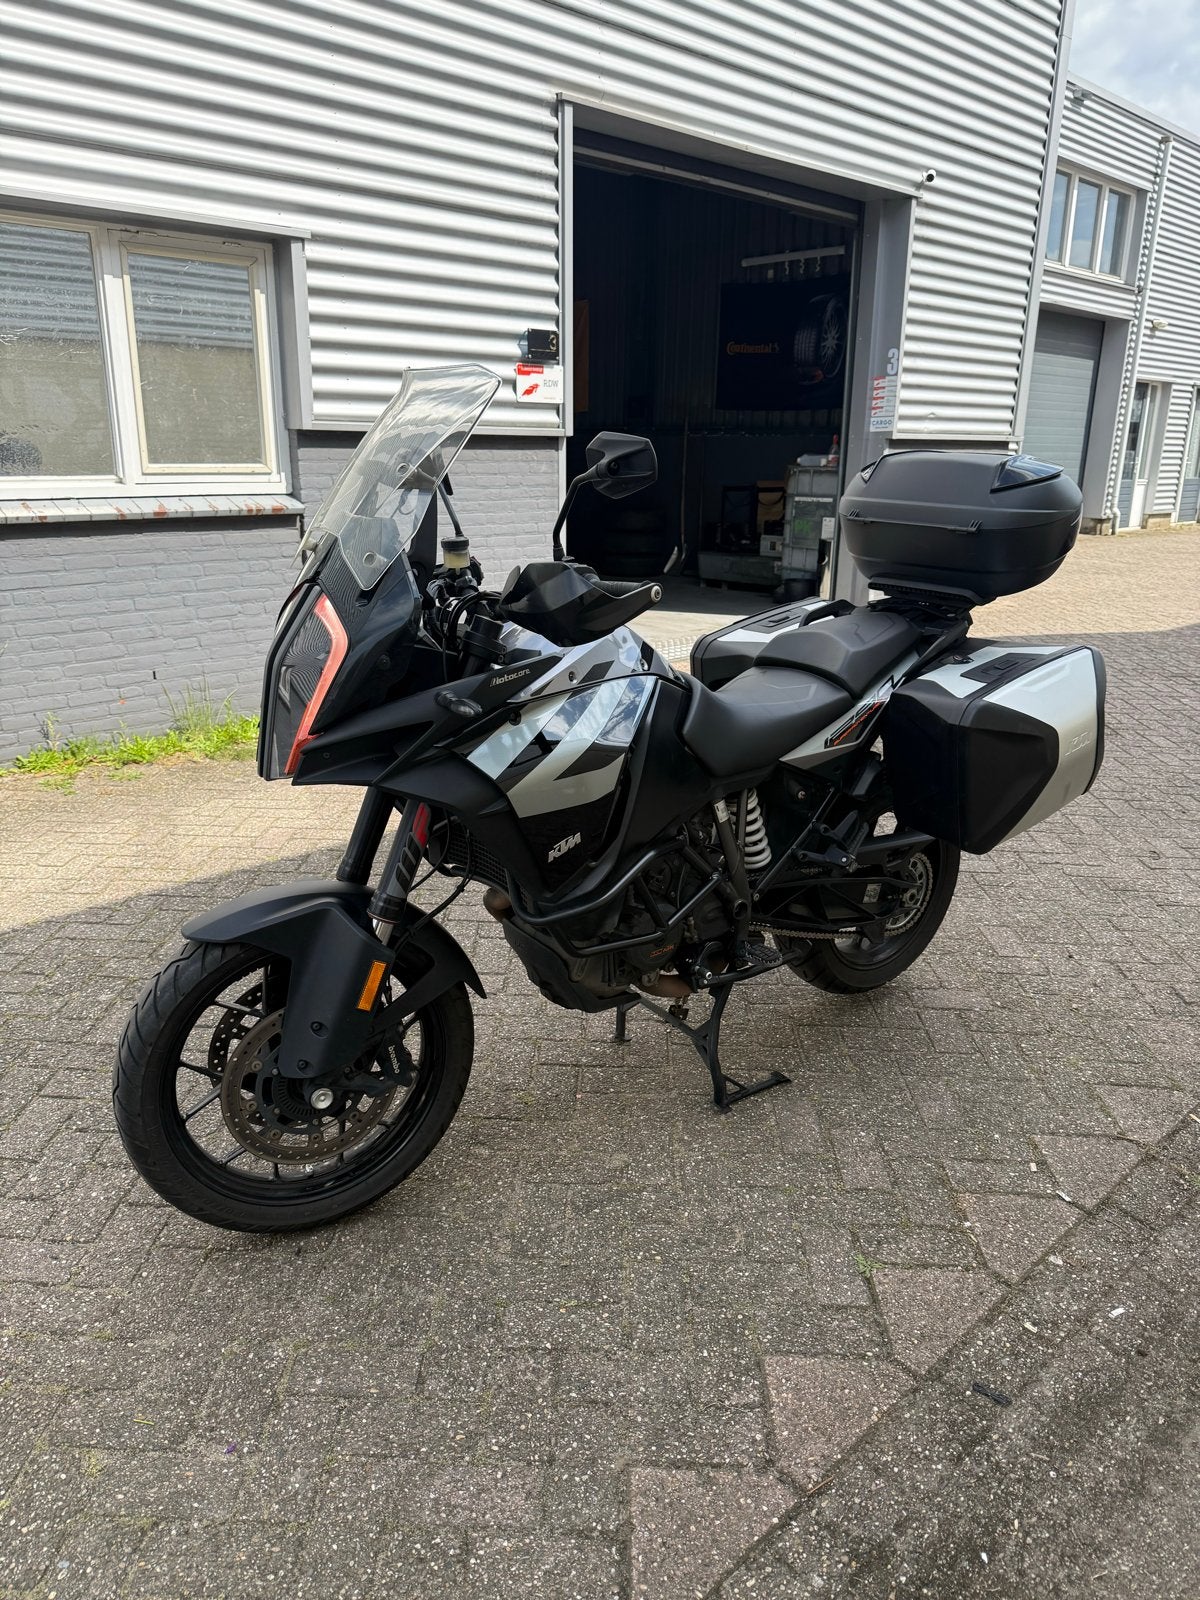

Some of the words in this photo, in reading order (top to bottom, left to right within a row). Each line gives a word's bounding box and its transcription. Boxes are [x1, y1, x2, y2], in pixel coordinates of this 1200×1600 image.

[727, 341, 771, 355] Continental
[887, 348, 899, 375] 3
[543, 379, 559, 387] RDW
[548, 832, 581, 863] KTM
[388, 1045, 400, 1073] brembo
